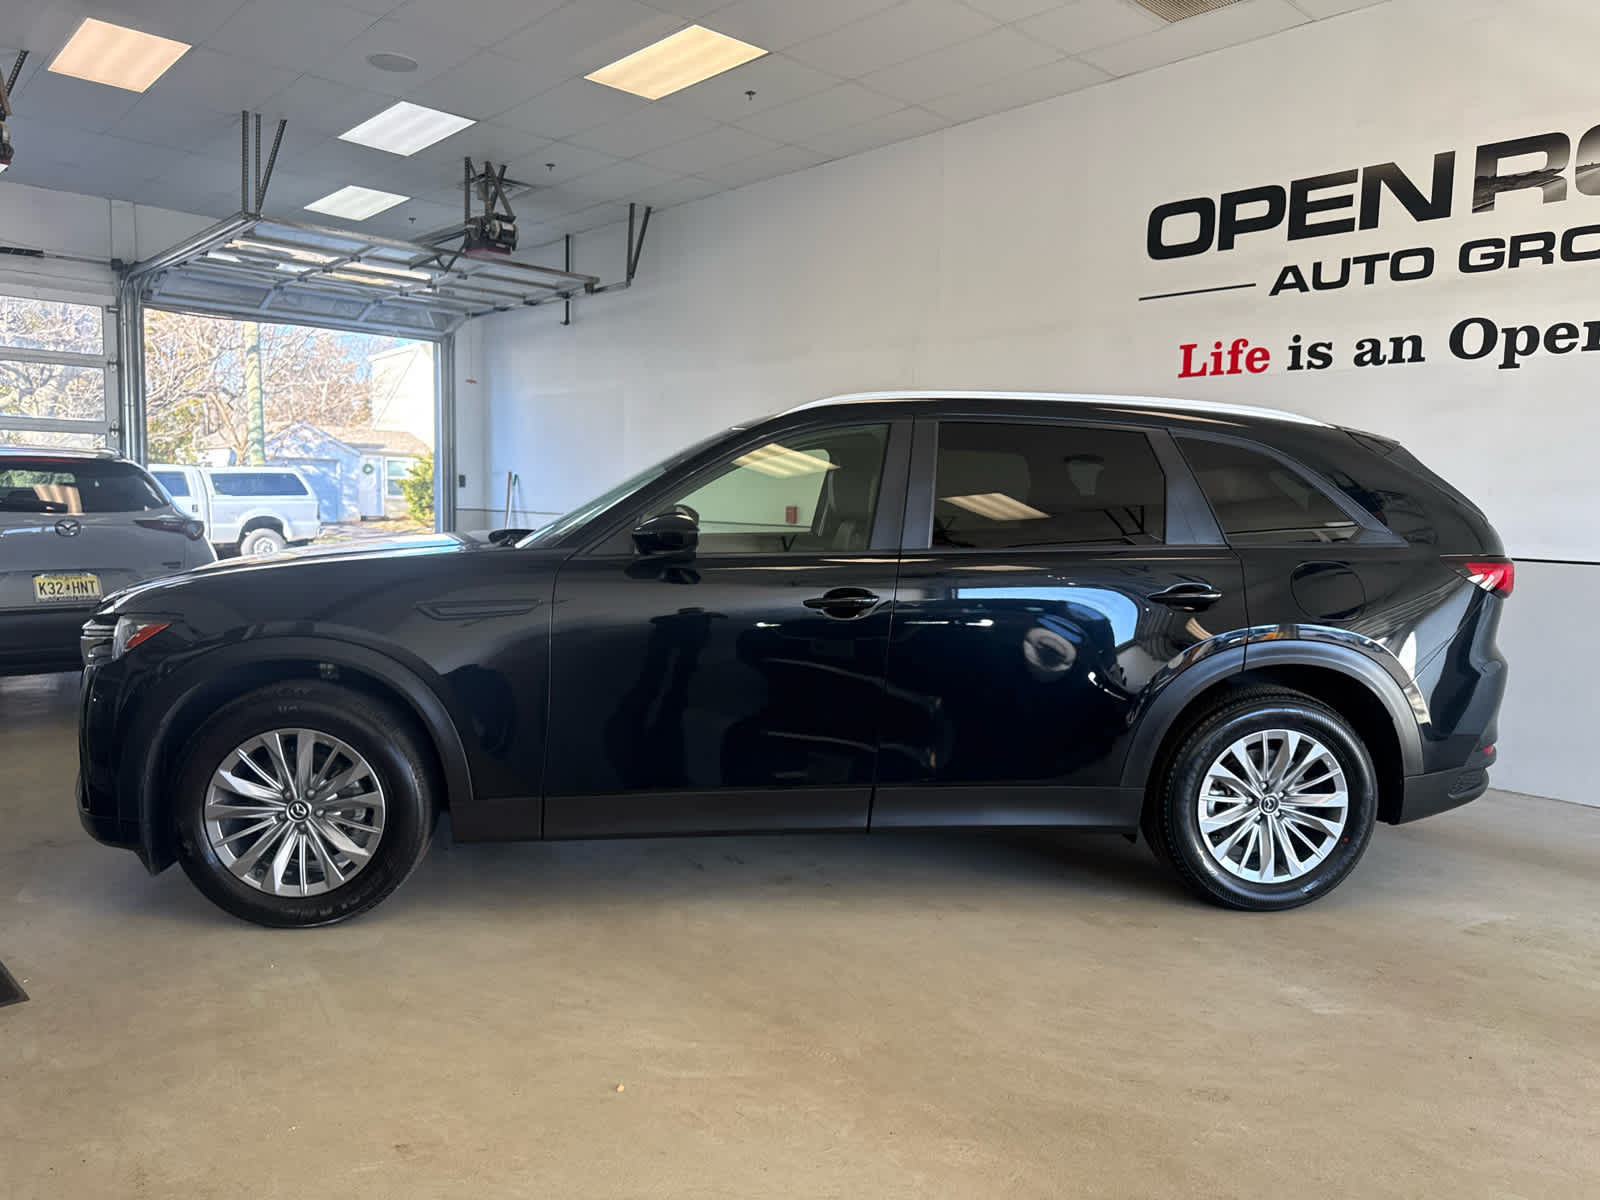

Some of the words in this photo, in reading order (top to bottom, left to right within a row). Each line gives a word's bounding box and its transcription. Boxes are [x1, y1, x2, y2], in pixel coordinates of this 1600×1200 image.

[1147, 151, 1456, 261] OPEN
[1472, 124, 1600, 214] R
[1268, 247, 1435, 297] AUTO
[1177, 338, 1271, 379] Life
[1287, 334, 1334, 371] is
[1353, 334, 1426, 367] an
